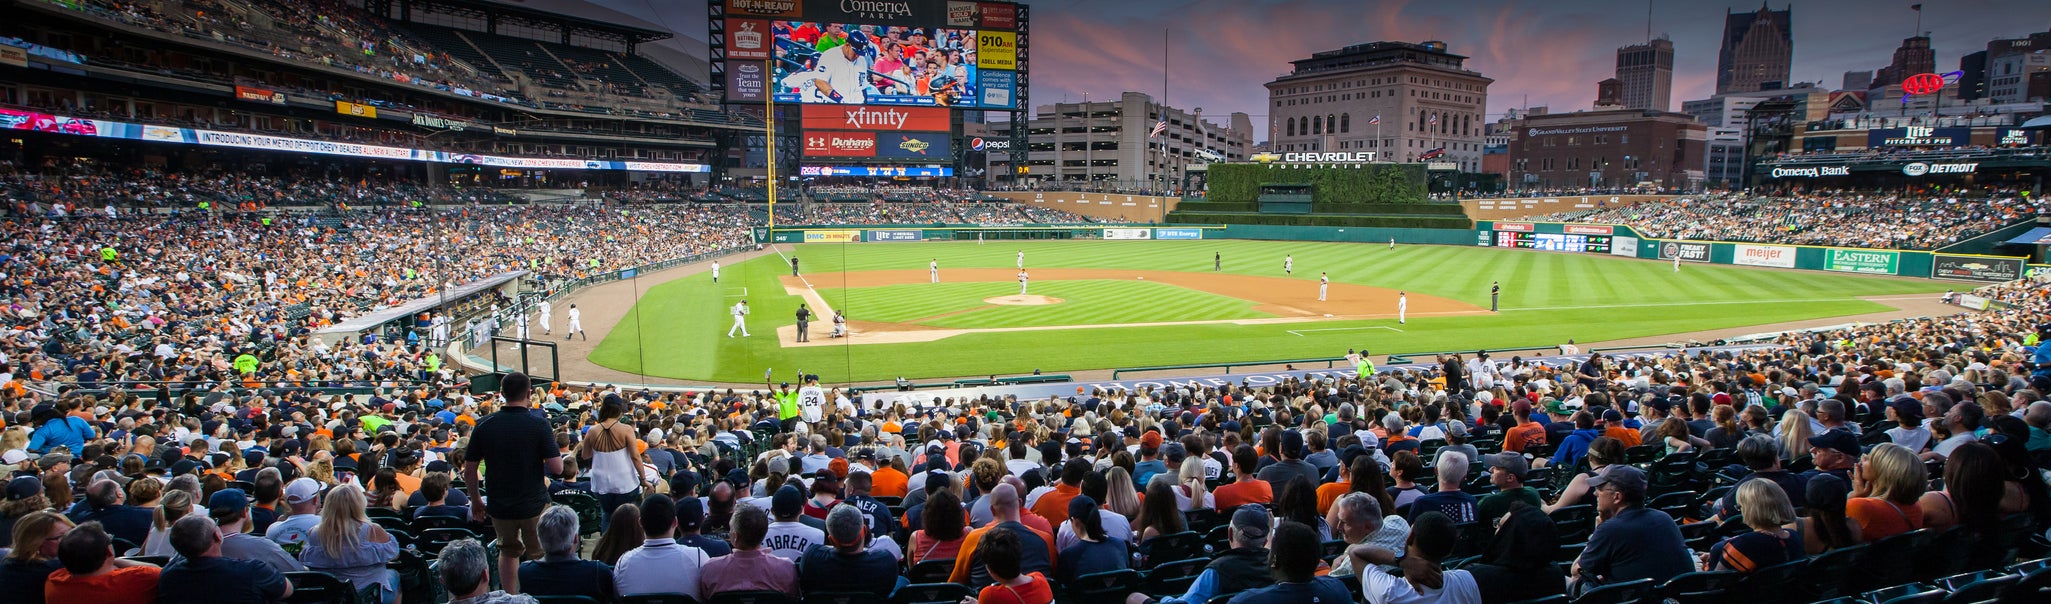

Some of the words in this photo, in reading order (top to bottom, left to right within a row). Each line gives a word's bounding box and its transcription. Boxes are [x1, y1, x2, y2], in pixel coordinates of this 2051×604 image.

[733, 0, 795, 11] HOT-N-READY
[860, 12, 894, 20] PARK
[981, 36, 1002, 47] 910
[2011, 40, 2032, 48] 1001
[737, 78, 762, 88] Team
[1903, 74, 1942, 95] AAA
[846, 107, 909, 129] xfinity
[1906, 126, 1934, 138] Lite
[2007, 130, 2024, 138] Lite
[203, 132, 252, 146] INTRODUCING
[253, 136, 271, 147] YOUR
[272, 138, 294, 149] METRO
[294, 140, 320, 152] DETROIT
[320, 142, 338, 152] CHEVY
[339, 144, 362, 154] DEALERS
[985, 140, 1010, 150] pepsi
[1285, 152, 1376, 162] CHEVROLET
[1820, 165, 1850, 176] Bank
[1929, 163, 1978, 174] DETROIT
[875, 231, 890, 241] Lite
[1178, 230, 1197, 238] Energy
[1679, 250, 1705, 259] FAST!
[1746, 247, 1782, 260] meijer
[1833, 250, 1890, 263] EASTERN
[805, 397, 818, 407] 24
